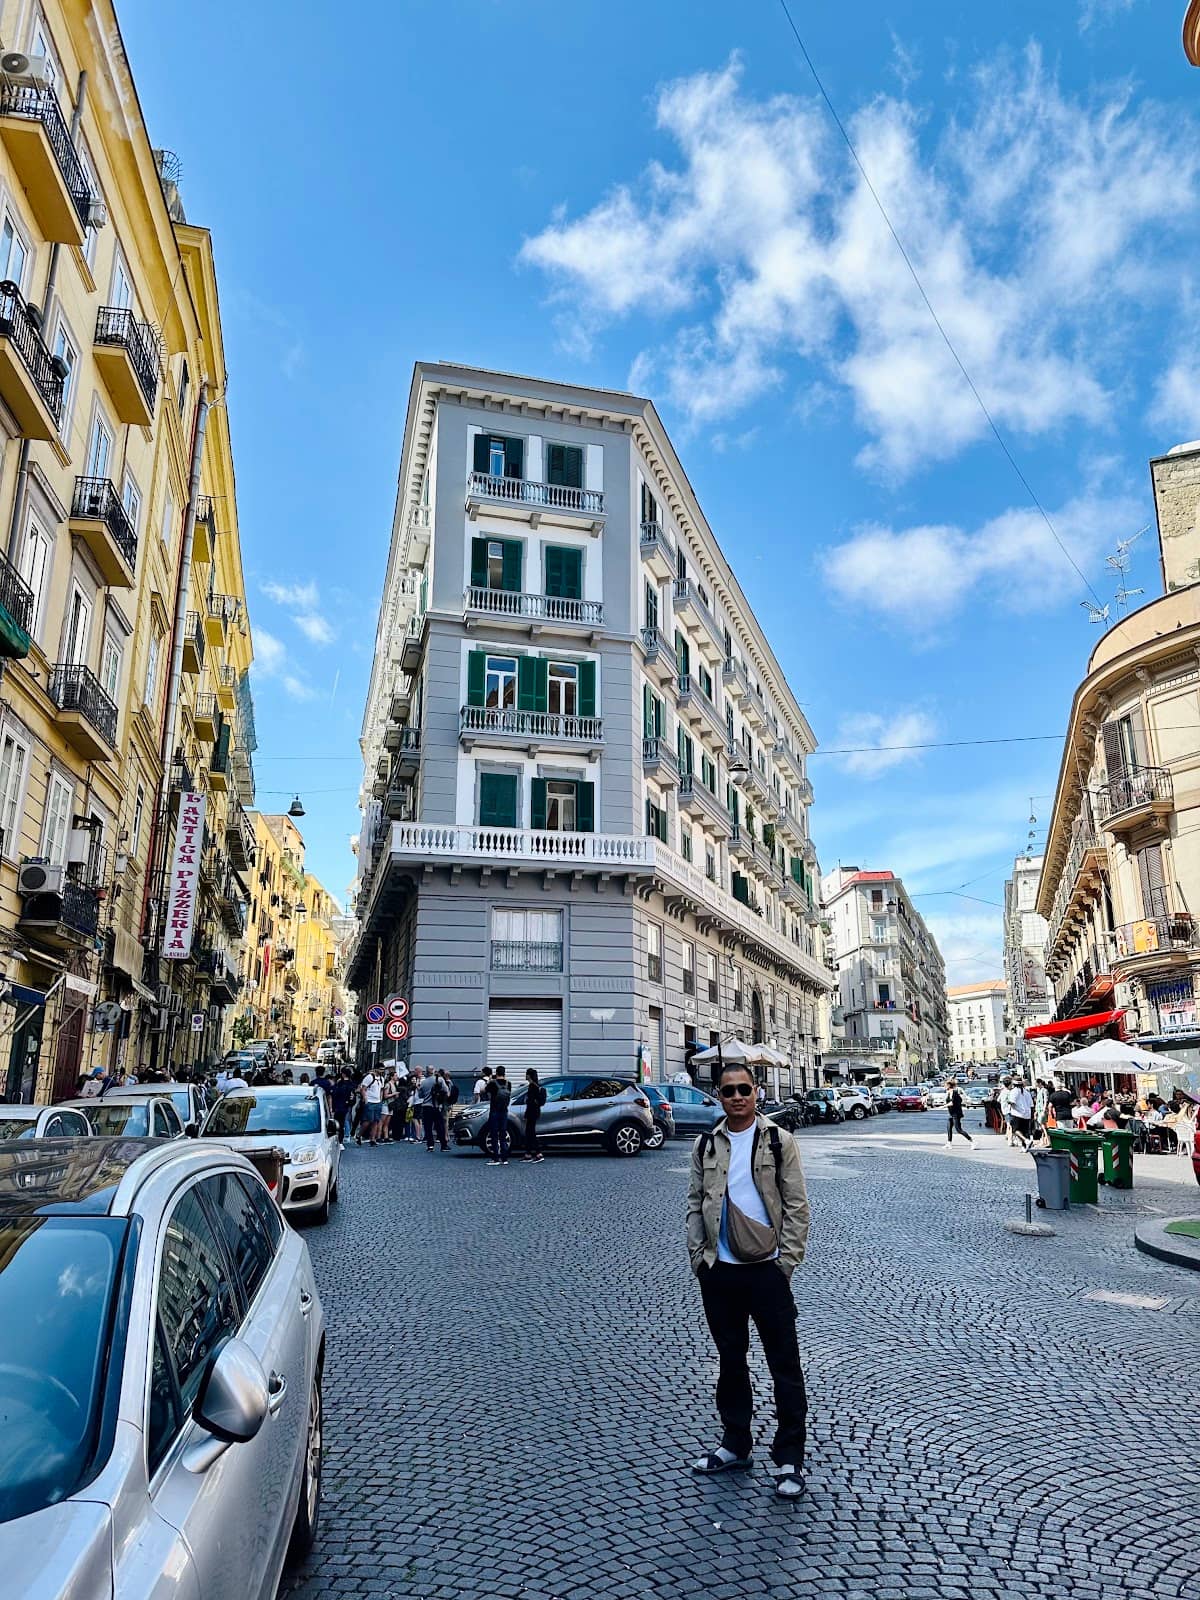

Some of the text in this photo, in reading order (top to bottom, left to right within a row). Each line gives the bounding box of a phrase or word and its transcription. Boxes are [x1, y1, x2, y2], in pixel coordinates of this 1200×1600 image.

[168, 871, 194, 949] PIZZERIA
[1011, 947, 1021, 1003] PIZZERIA
[391, 1024, 404, 1035] 30
